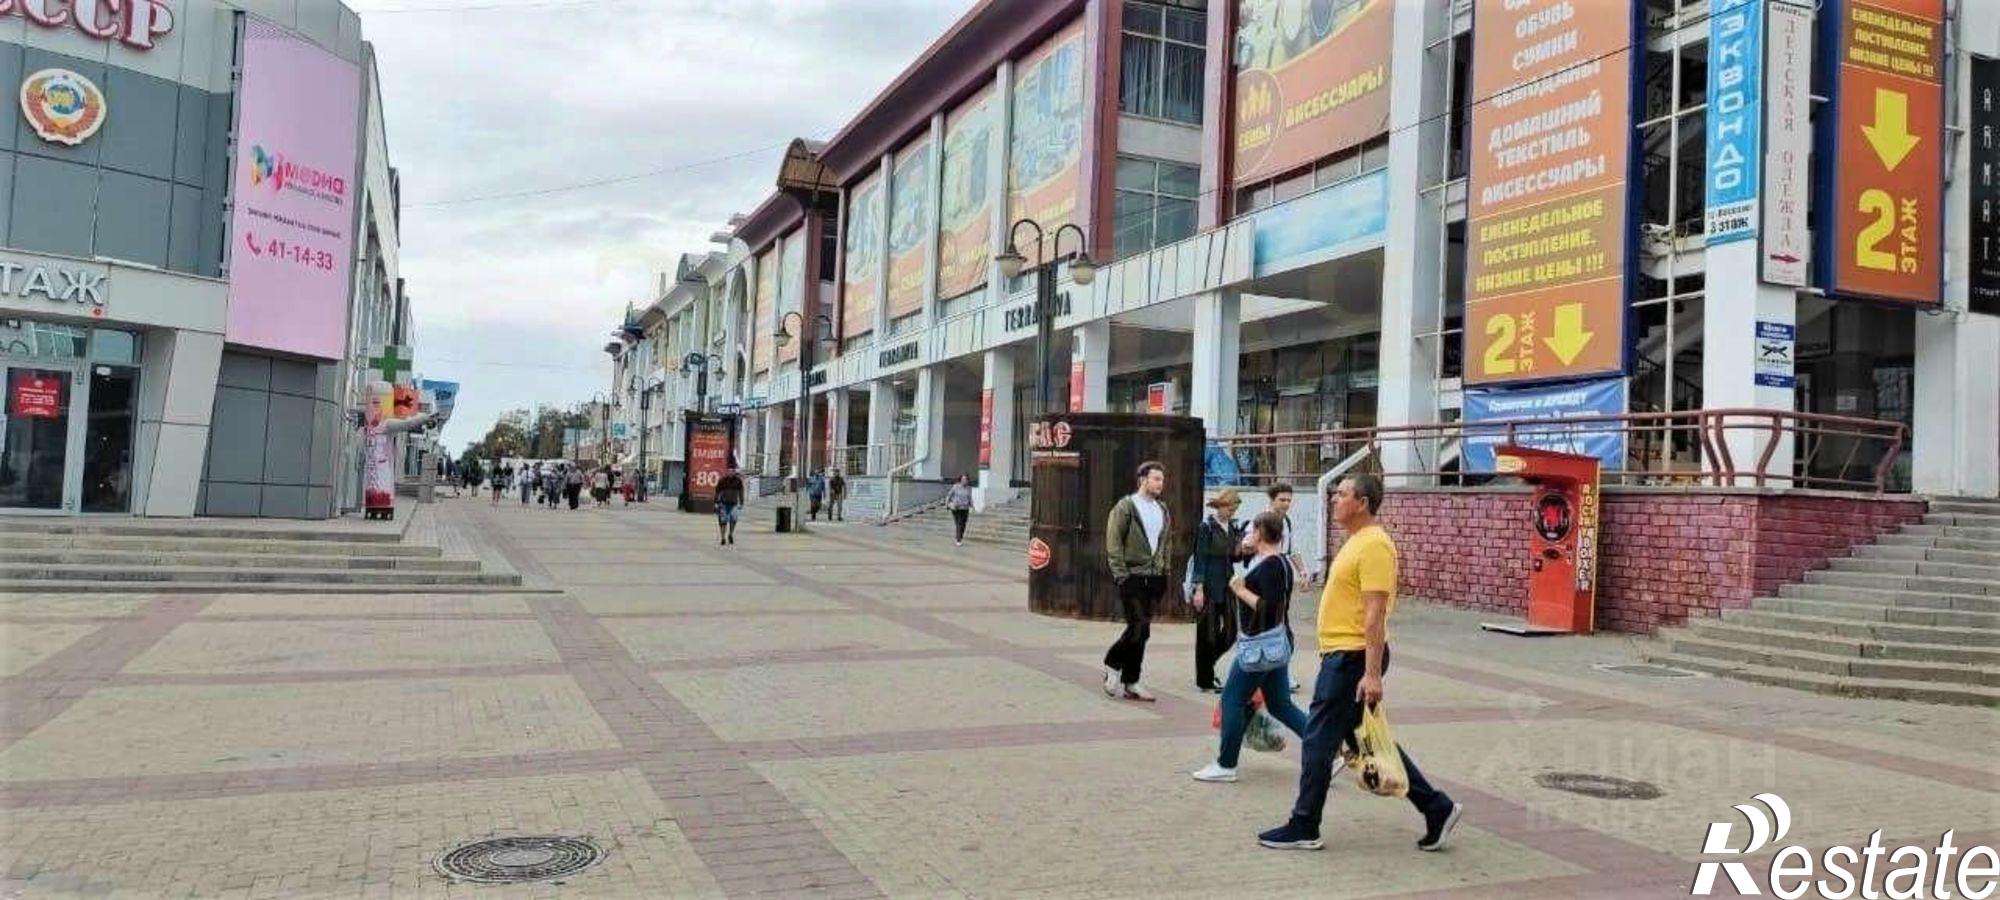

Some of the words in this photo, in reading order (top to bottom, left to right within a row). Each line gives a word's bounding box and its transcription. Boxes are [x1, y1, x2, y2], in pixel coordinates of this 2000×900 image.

[0, 0, 174, 49] ССР
[1516, 1, 1574, 38] ОБУВЬ
[1852, 7, 1932, 40] ЕЖЕНЕДЕЛЬНОЕ
[1512, 29, 1578, 70] СУМКИ
[1284, 62, 1385, 129] АКСЕССУАРЫ
[1490, 55, 1600, 109] ЧЕМОДАНЫ
[1488, 90, 1602, 152] ДОМАШНИЙ
[1496, 125, 1591, 169] ТЕКСТИЛЬ
[1481, 154, 1606, 207] АКСЕССУАРЫ
[1480, 198, 1603, 243] ЕЖЕНЕДЕЛЬНОЕ
[1857, 188, 1896, 271] 2
[1900, 197, 1918, 275] ЭТАЖ
[267, 238, 333, 272] 41-14-33
[1475, 267, 1533, 293] НИЗКИЕ
[1534, 255, 1583, 284] ЦЕНЫ
[1483, 312, 1517, 375] 2
[1519, 310, 1537, 372] ЭТАЖ
